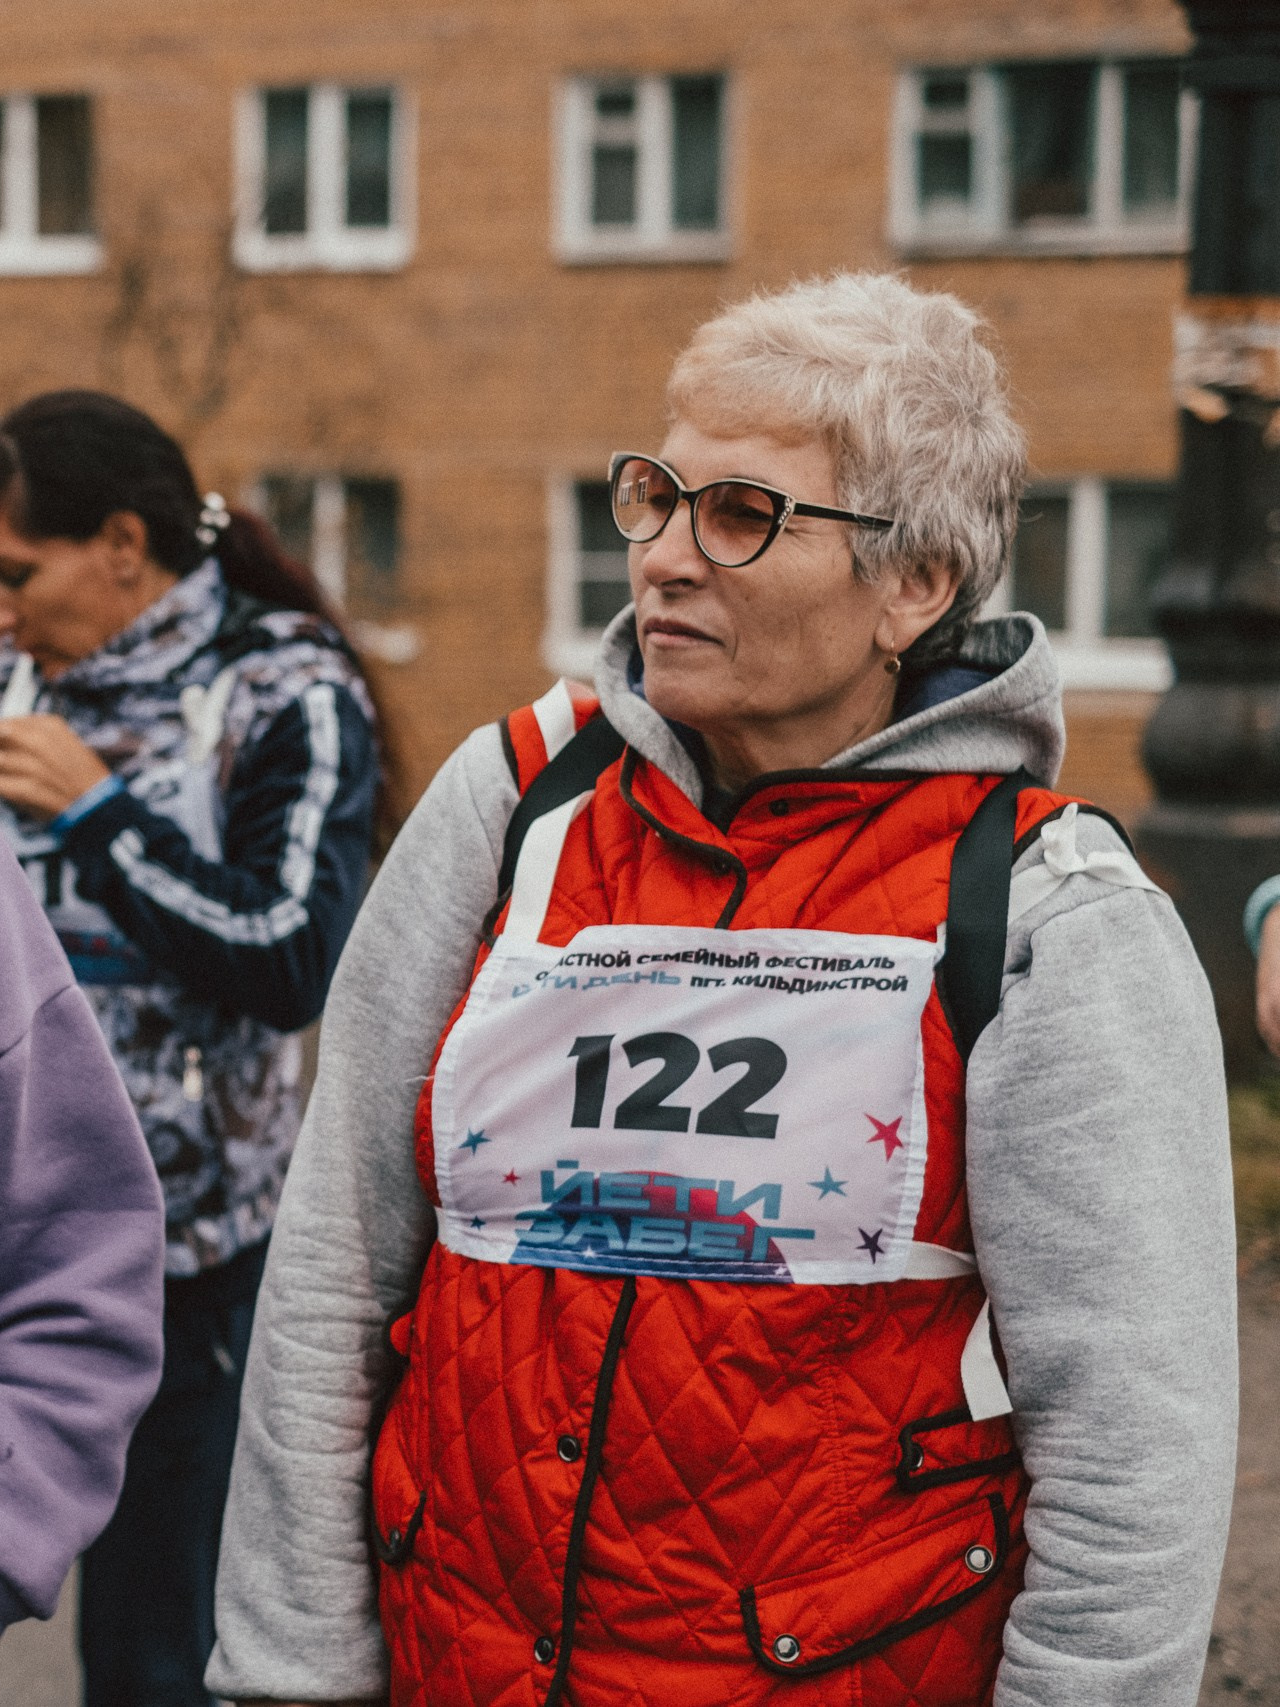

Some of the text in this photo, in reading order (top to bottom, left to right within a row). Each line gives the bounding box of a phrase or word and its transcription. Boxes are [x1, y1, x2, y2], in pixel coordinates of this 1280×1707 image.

[582, 970, 681, 991] ДЕНЬ
[732, 974, 908, 995] КИЛЬДИНСТРОЙ
[637, 948, 760, 969] СЕМЕЙНЫЙ
[765, 955, 895, 972] ФЕСТИВАЛЬ
[567, 1031, 787, 1139] 122
[540, 1160, 782, 1220] ЙЕТИ
[514, 1209, 816, 1262] ЗАБЕГ
